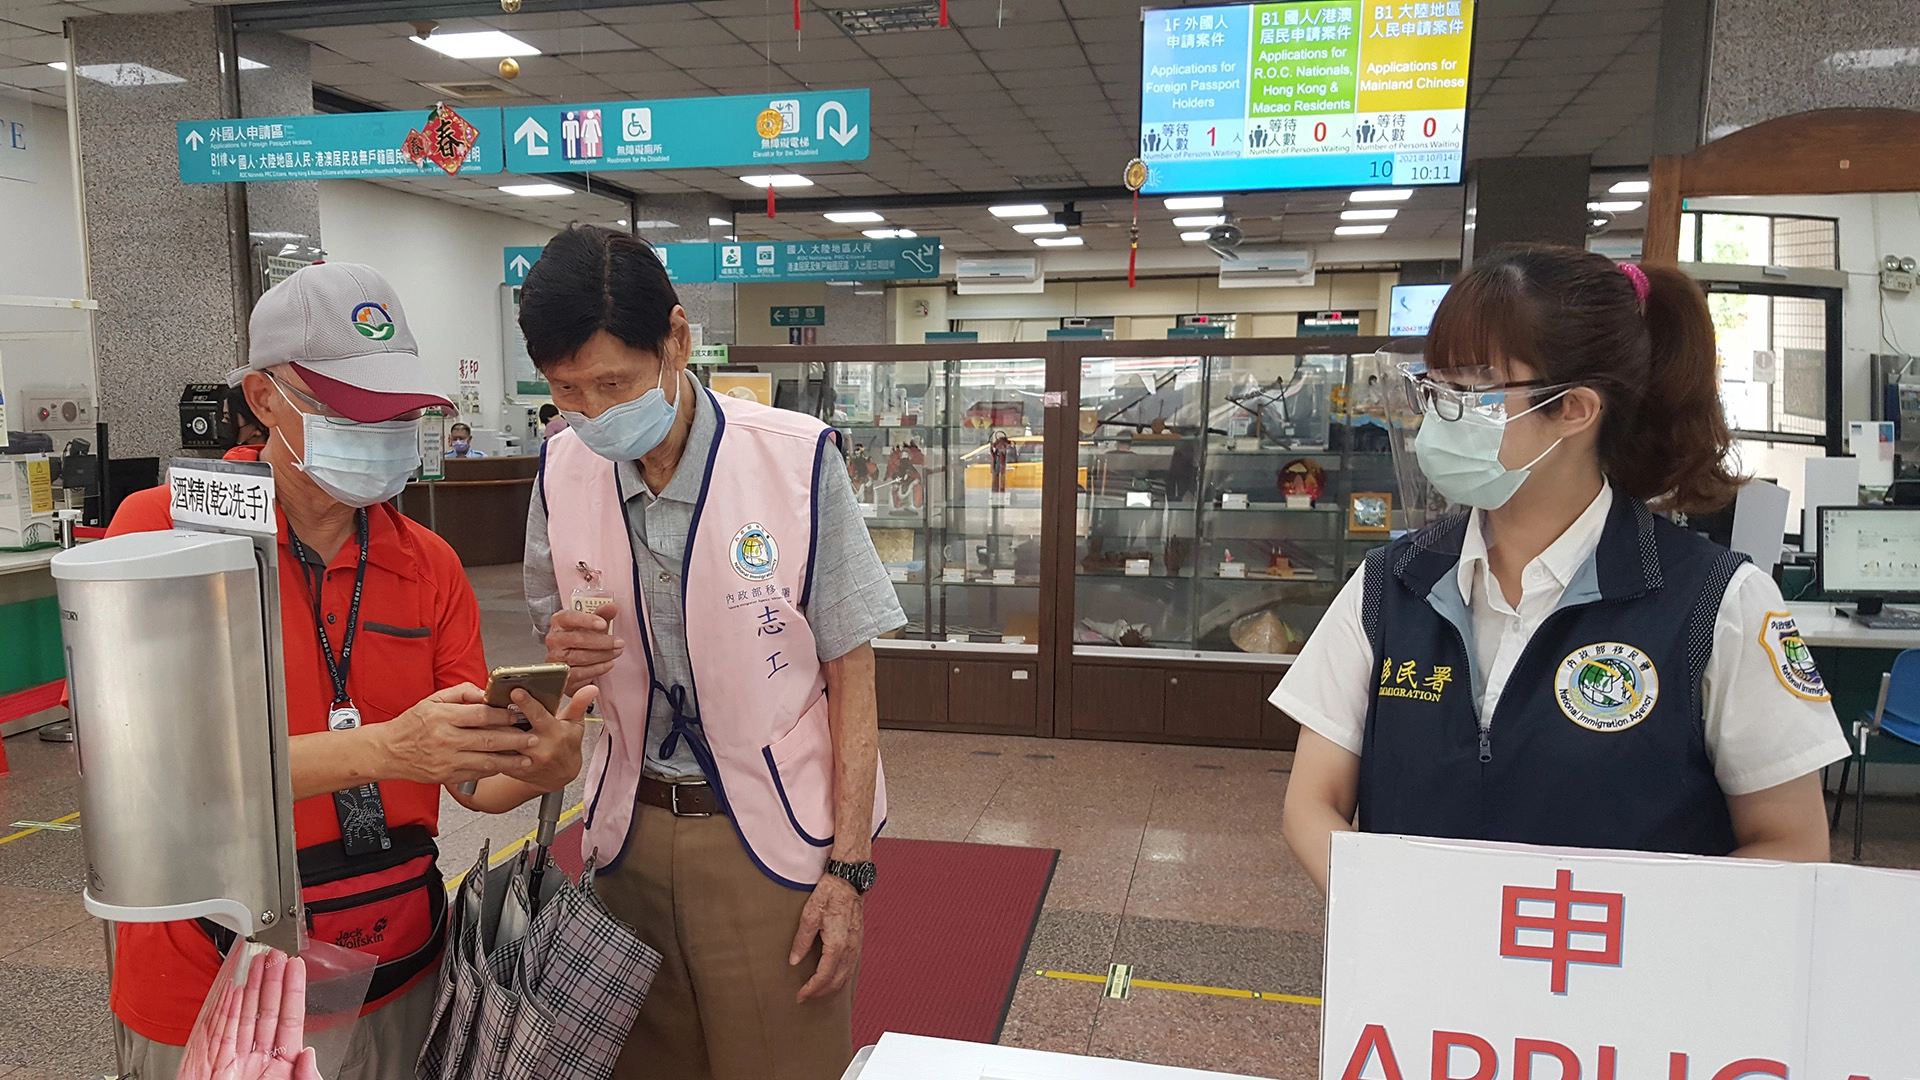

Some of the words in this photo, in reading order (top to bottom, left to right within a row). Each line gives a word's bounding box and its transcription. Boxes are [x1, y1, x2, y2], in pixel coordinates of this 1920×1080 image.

[1261, 12, 1280, 26] B1
[1284, 7, 1353, 25] 國人/港澳
[1375, 5, 1393, 20] B1
[1398, 1, 1461, 19] 大陸地區
[1164, 18, 1180, 31] 1F
[1185, 15, 1228, 31] 外國人
[1369, 19, 1464, 38] 人民申請案件
[1166, 32, 1225, 48] 申請案件
[1260, 25, 1352, 44] 居民申請案件
[1258, 49, 1328, 63] Applications
[1331, 47, 1347, 57] for
[1150, 63, 1218, 78] Applications
[1221, 61, 1236, 72] for
[1254, 66, 1293, 79] R.O.C.
[1296, 64, 1353, 77] Nationals,
[1366, 60, 1438, 76] Applications
[1441, 58, 1457, 70] for
[1145, 80, 1187, 94] Foreign
[1190, 79, 1240, 92] Passport
[1263, 85, 1294, 98] Hong
[1297, 83, 1327, 96] Kong
[1330, 81, 1339, 93] &
[1360, 78, 1413, 91] Mainland
[1416, 77, 1465, 89] Chinese
[1172, 97, 1215, 109] Holders
[1253, 102, 1291, 113] Macao
[1294, 99, 1351, 111] Residents
[210, 124, 283, 142] 外國人申請區
[1269, 118, 1297, 132] 等待
[1314, 121, 1327, 142] 0
[1342, 128, 1351, 138] 人
[1377, 114, 1406, 128] 等待
[1423, 117, 1437, 138] 0
[1452, 123, 1461, 134] 人
[436, 119, 465, 157] 春
[1162, 123, 1189, 137] 等待
[1207, 126, 1216, 146] 1
[1233, 133, 1242, 143] 人
[1269, 133, 1296, 147] 人數
[1376, 129, 1405, 142] 人數
[210, 142, 240, 150] Applications
[1162, 138, 1189, 151] 人數
[1291, 145, 1319, 153] Persons
[1321, 145, 1350, 153] Waiting
[1430, 141, 1460, 149] Waiting
[753, 150, 774, 158] Elevator
[795, 148, 818, 156] Disabled
[1143, 152, 1172, 160] Number
[1174, 151, 1182, 159] of
[1183, 150, 1211, 158] Persons
[1212, 149, 1241, 158] Waiting
[1399, 153, 1460, 162] 2021年10月14日
[1369, 160, 1393, 178] 10
[1411, 166, 1450, 180] 10:11
[459, 359, 479, 379] 影印
[172, 475, 268, 523] 酒精(乾洗手)
[725, 584, 791, 605] 內政部移署
[1559, 688, 1578, 718] National
[1577, 711, 1629, 729] Immigration
[1629, 694, 1654, 722] Agency
[335, 928, 363, 941] Jack
[1500, 869, 1626, 995] 申
